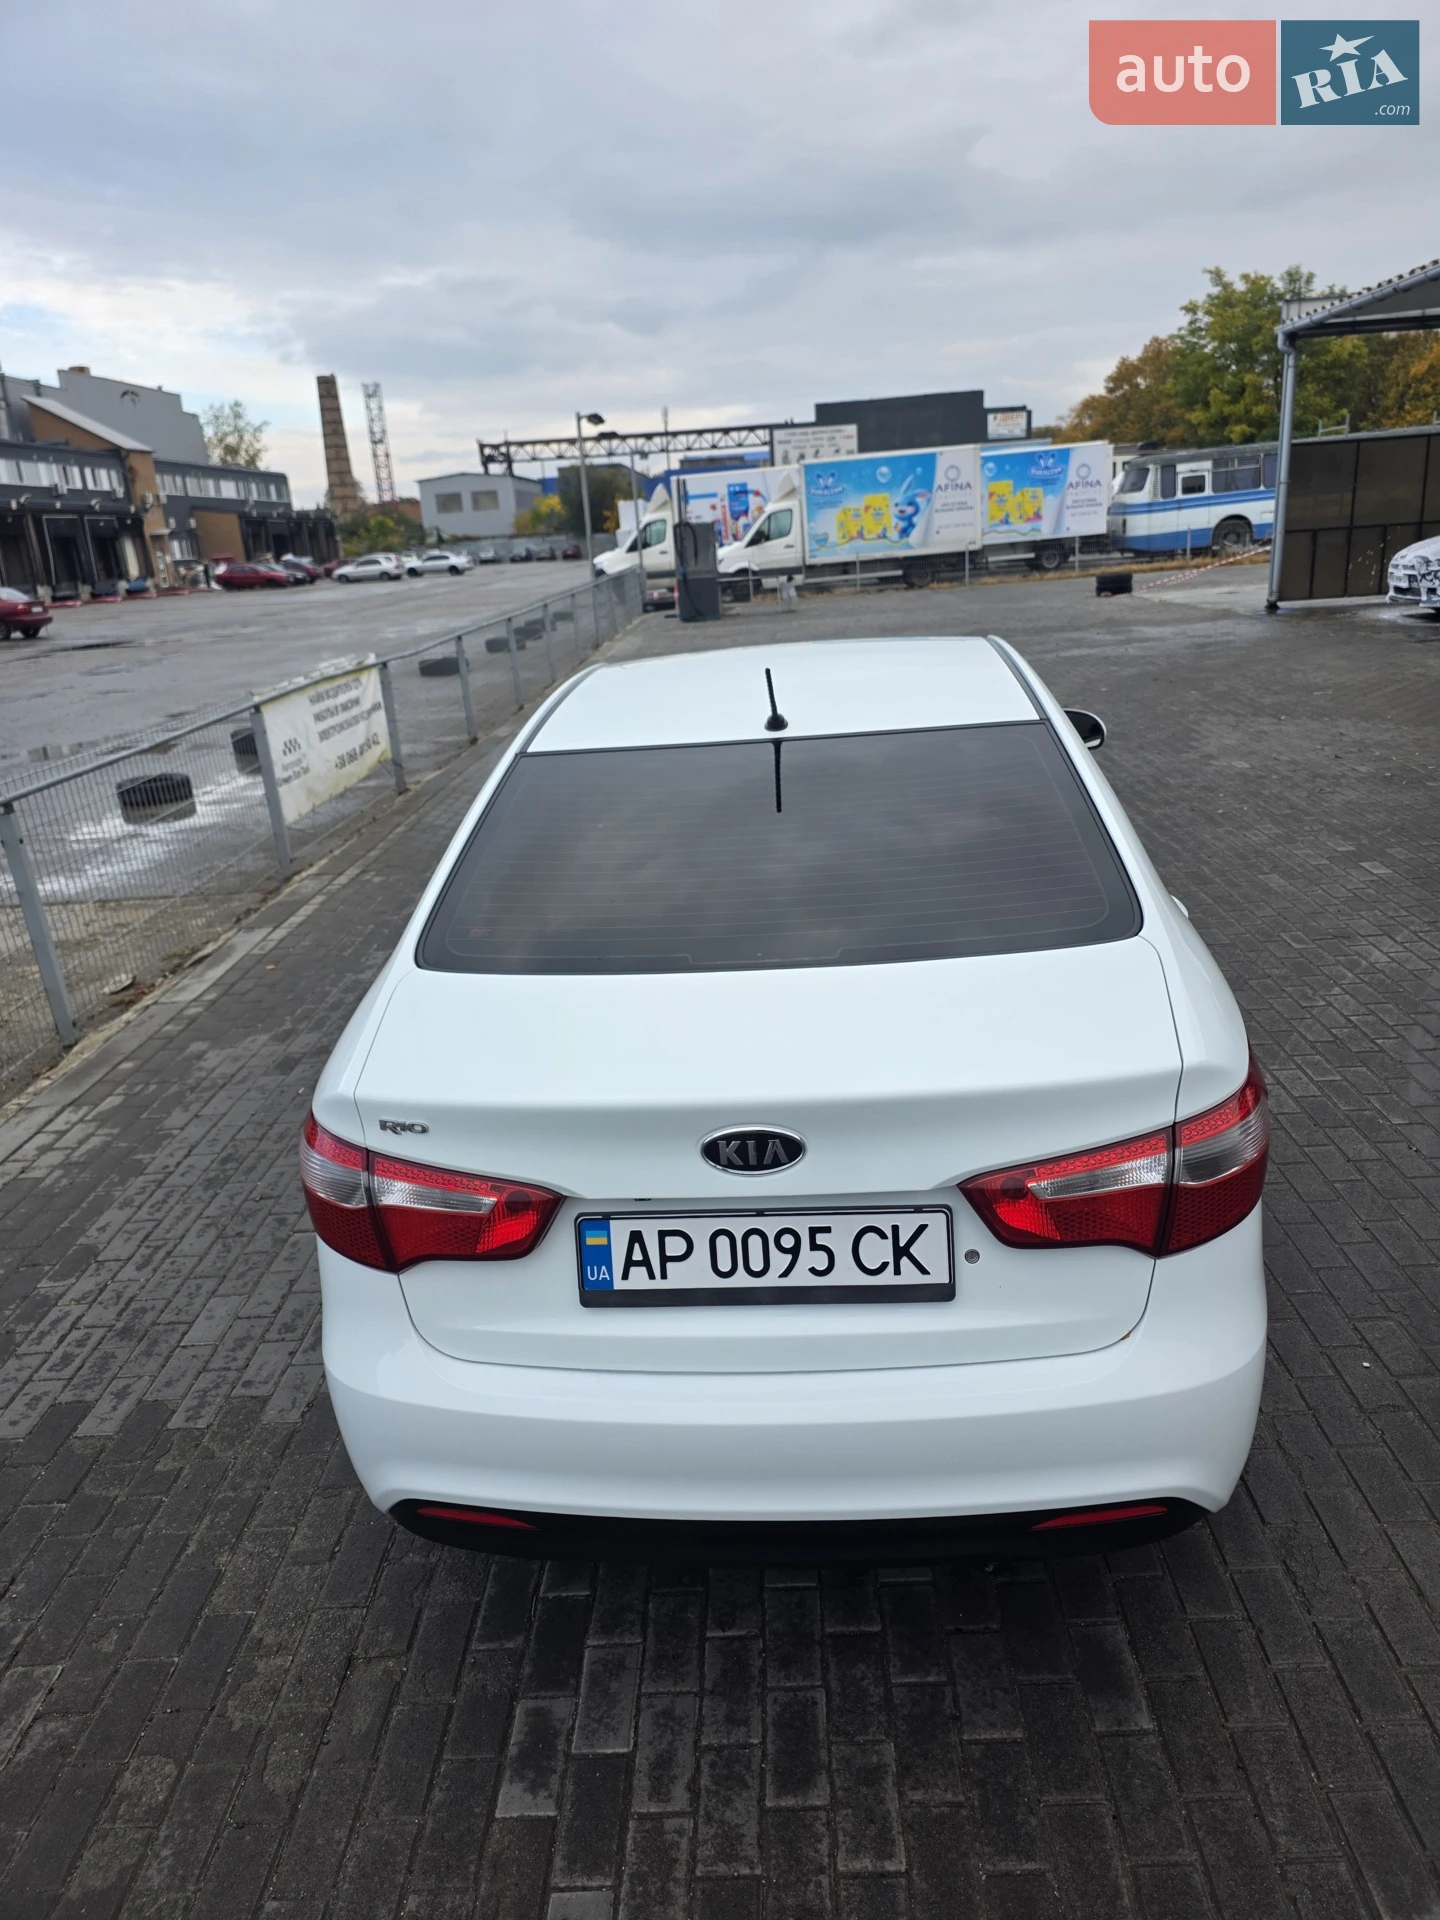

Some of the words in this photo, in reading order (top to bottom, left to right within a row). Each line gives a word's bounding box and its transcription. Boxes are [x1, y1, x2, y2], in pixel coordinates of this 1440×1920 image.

[935, 481, 972, 492] AFINA
[1067, 479, 1102, 490] AFINA
[379, 1120, 429, 1135] RIO
[717, 1139, 789, 1165] KIA
[621, 1229, 694, 1280] AP
[709, 1226, 835, 1279] 0095
[851, 1224, 931, 1276] CK
[587, 1265, 610, 1281] UA
